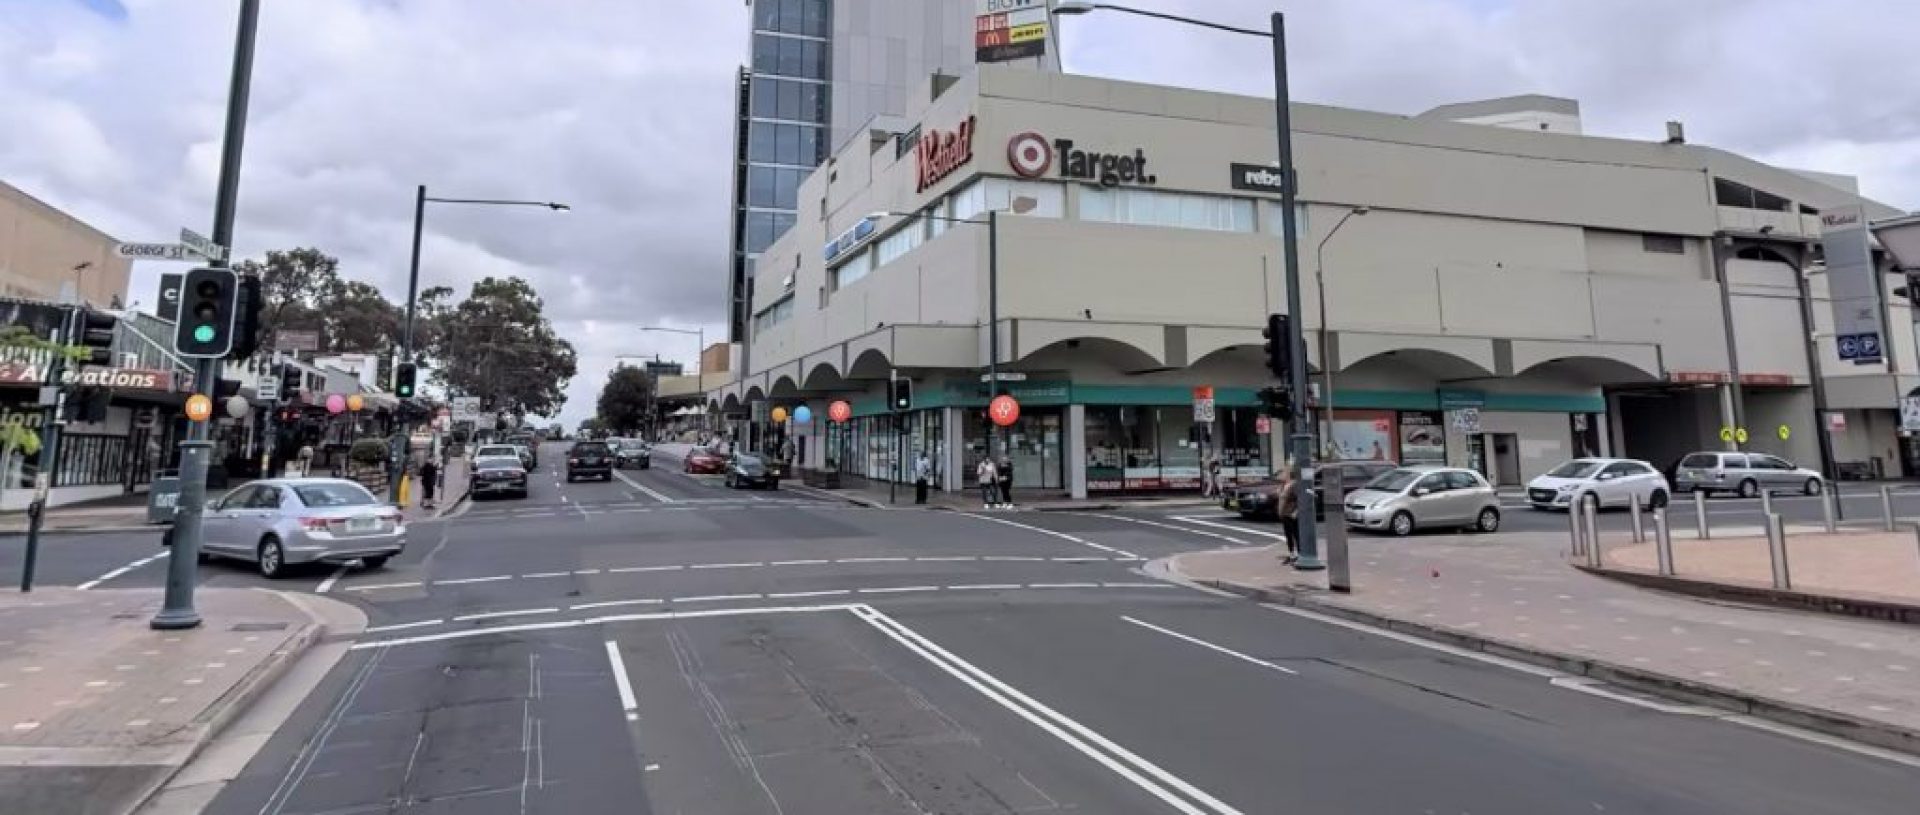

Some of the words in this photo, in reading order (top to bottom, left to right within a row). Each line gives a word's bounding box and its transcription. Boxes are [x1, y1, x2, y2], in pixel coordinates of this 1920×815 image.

[914, 115, 976, 194] Westfield
[120, 243, 164, 257] GEORGE
[18, 364, 155, 387] Alerations
